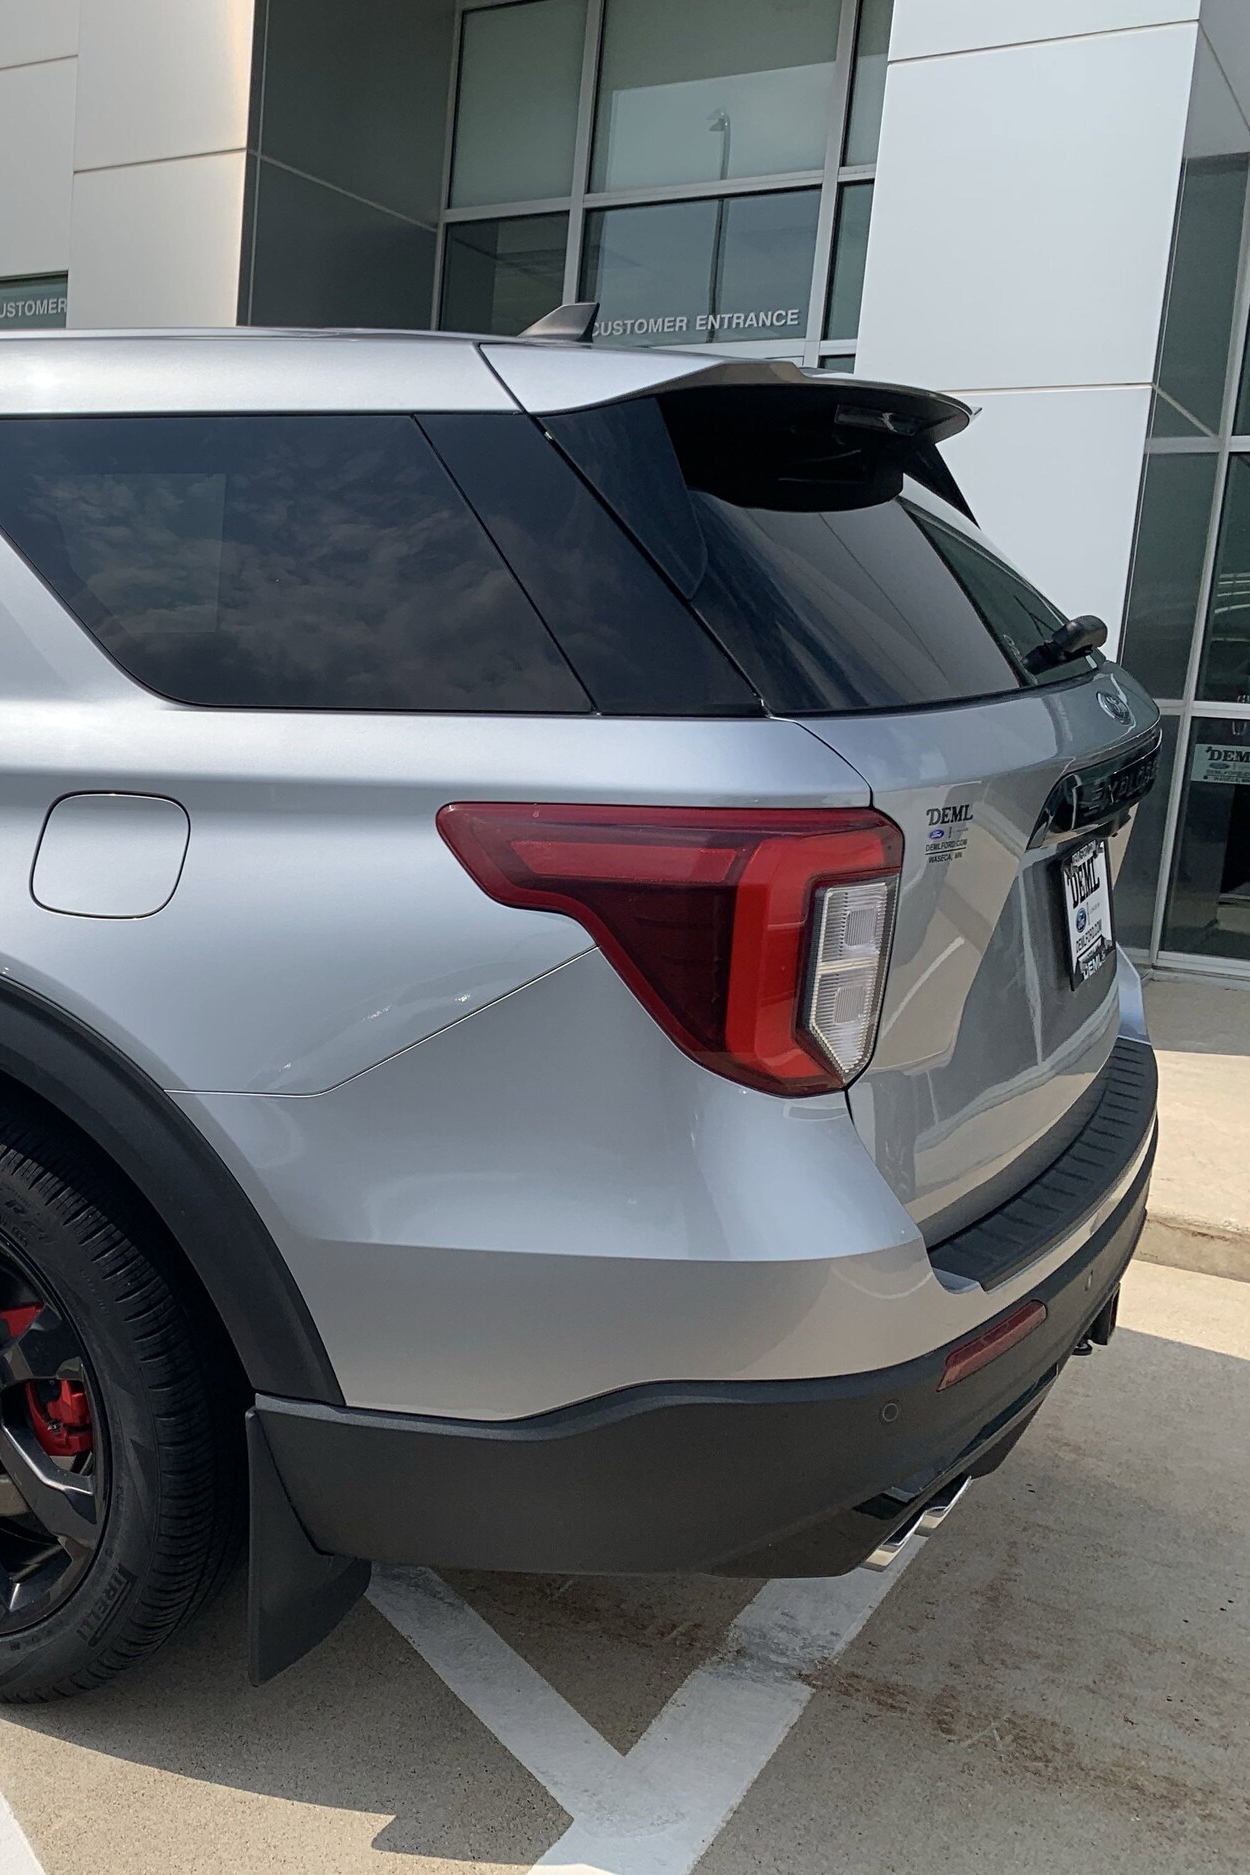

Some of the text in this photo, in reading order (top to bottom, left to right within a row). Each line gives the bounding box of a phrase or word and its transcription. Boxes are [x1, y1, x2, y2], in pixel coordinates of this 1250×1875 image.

[592, 309, 800, 337] CUSTOMER ENTRANCE
[926, 804, 974, 826] DEML
[925, 839, 968, 852] DEMLFORD.COM
[1067, 857, 1101, 909] DEML
